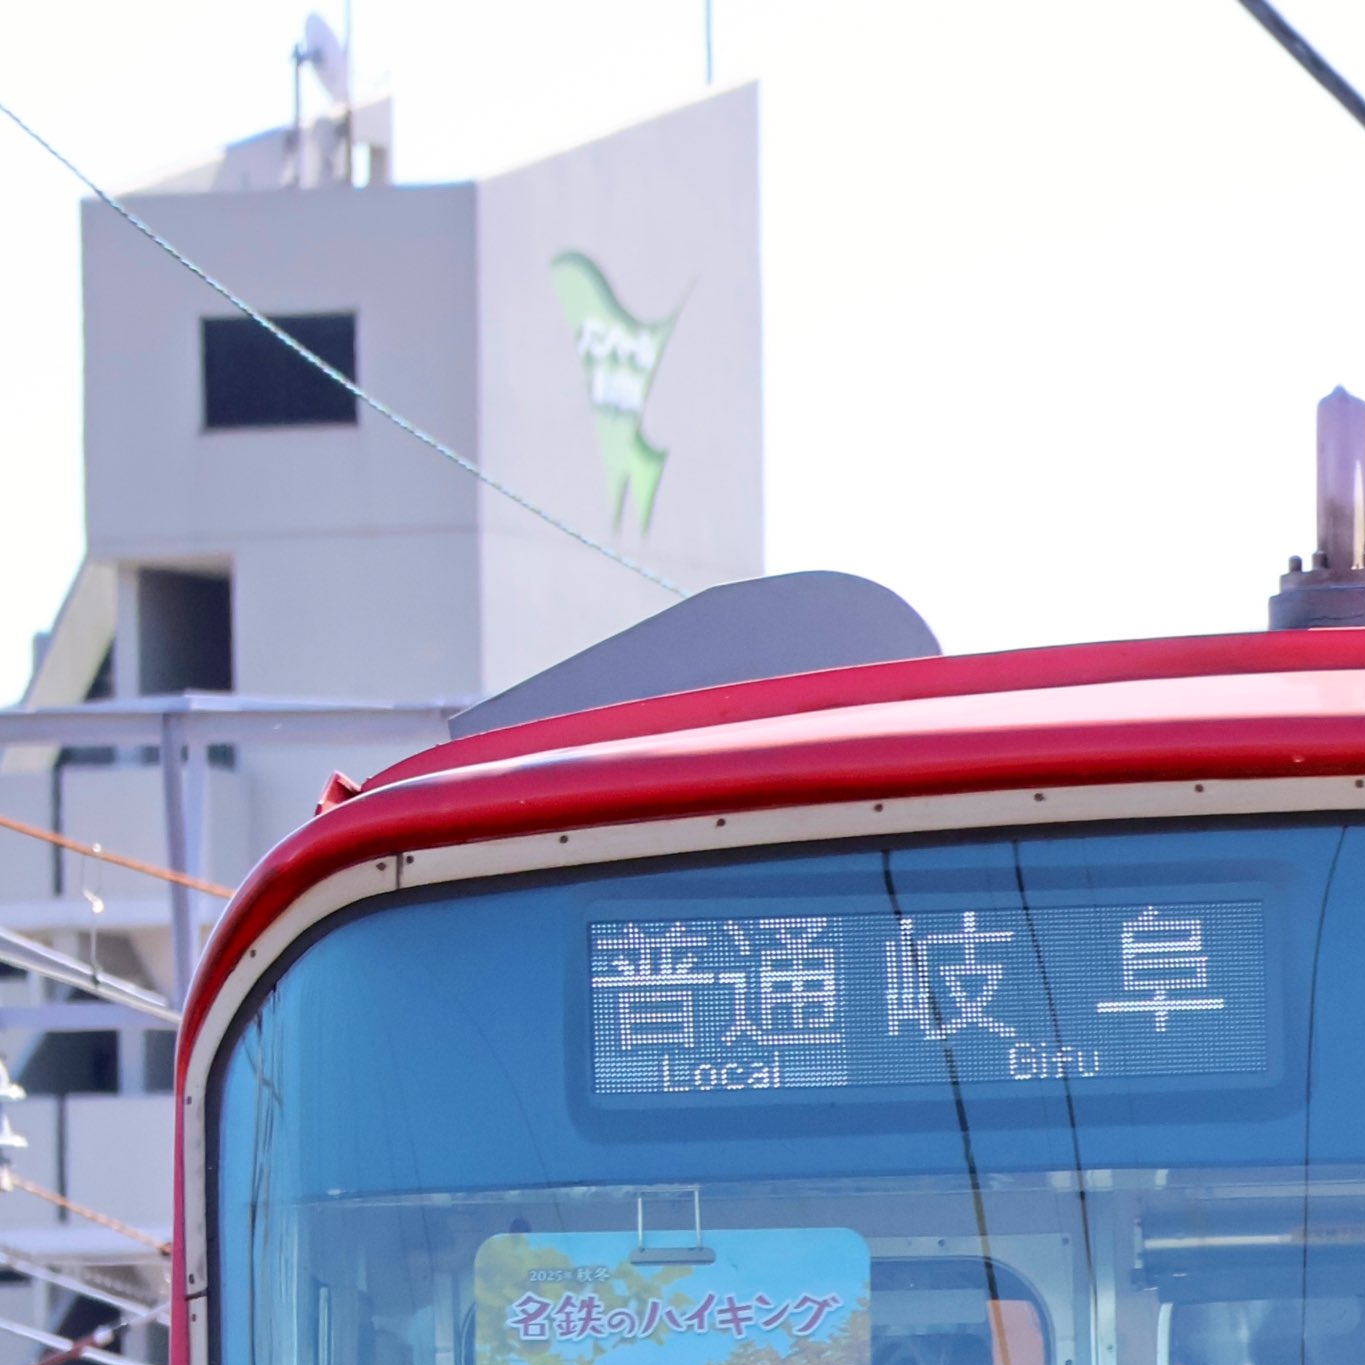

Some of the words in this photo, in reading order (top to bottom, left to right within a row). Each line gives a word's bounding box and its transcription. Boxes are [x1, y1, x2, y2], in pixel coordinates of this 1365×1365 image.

[592, 917, 842, 1050] 普通
[662, 1052, 781, 1092] Local
[1008, 1042, 1100, 1080] Gifu
[508, 1291, 841, 1341] 名鉄のハイキング
